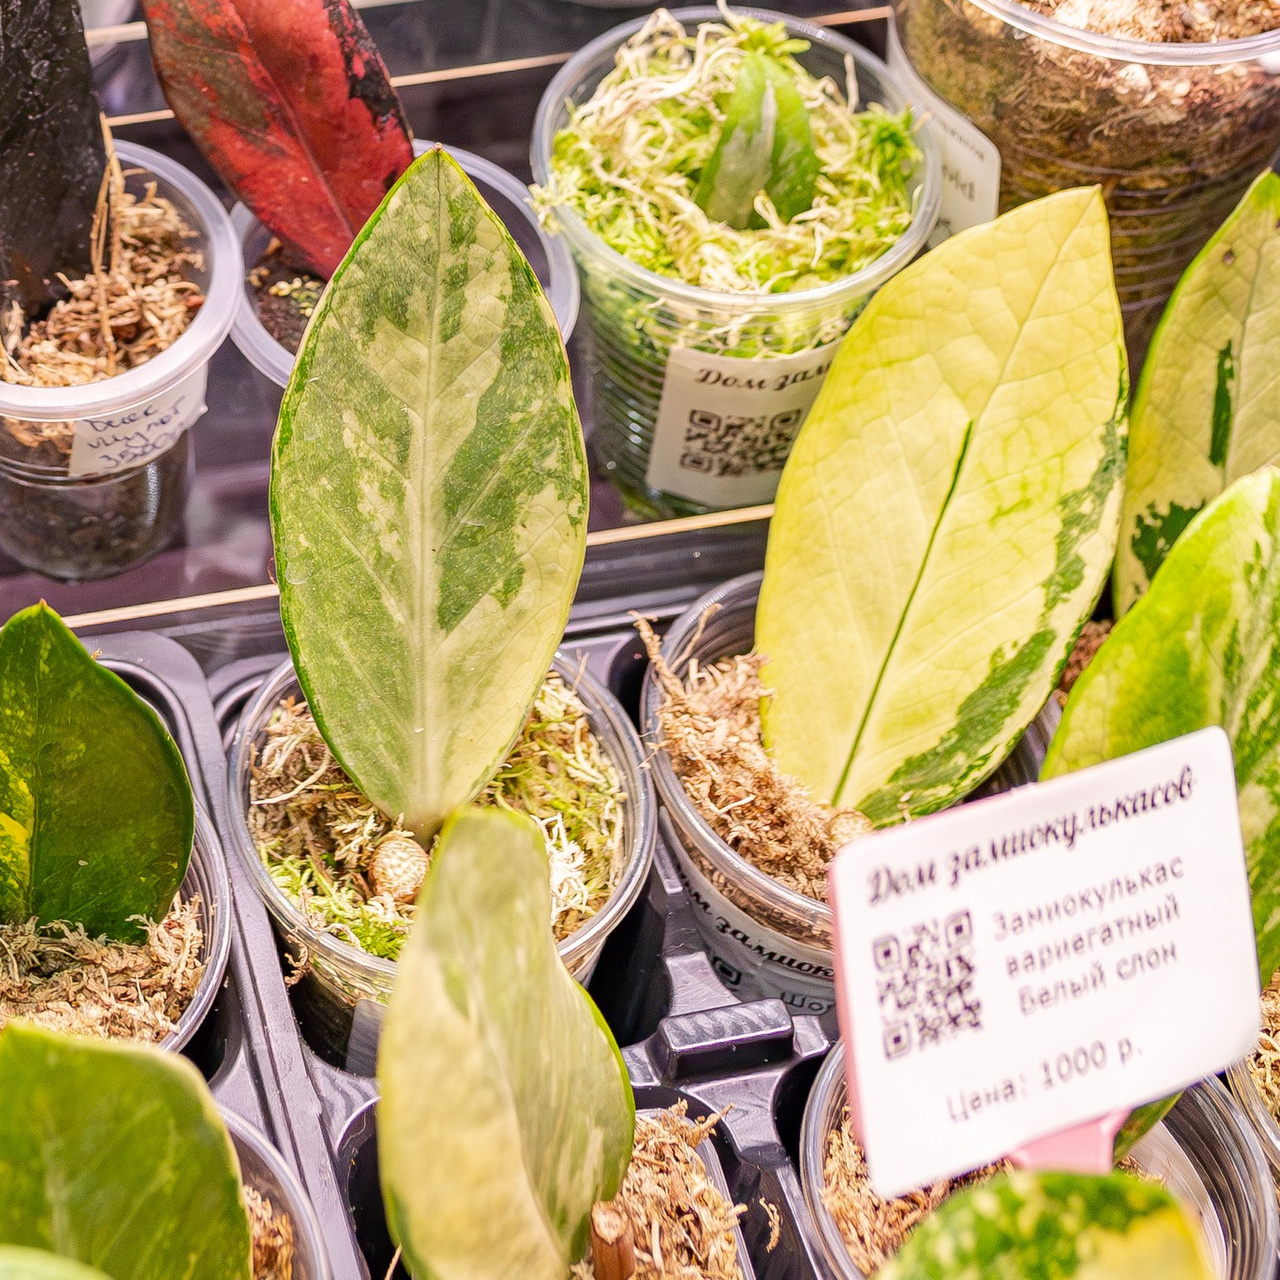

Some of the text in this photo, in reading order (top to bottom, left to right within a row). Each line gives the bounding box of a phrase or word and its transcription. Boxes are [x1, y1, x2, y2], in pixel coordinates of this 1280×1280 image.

[694, 367, 768, 390] Дом
[867, 764, 1196, 906] Дом замиокулькасов
[993, 855, 1186, 942] Замиокулькас
[1005, 892, 1181, 977] вариегатный
[714, 915, 836, 978] замиок
[1017, 941, 1177, 1016] Белый слон
[946, 1038, 1144, 1123] Цена: 1000 р.
